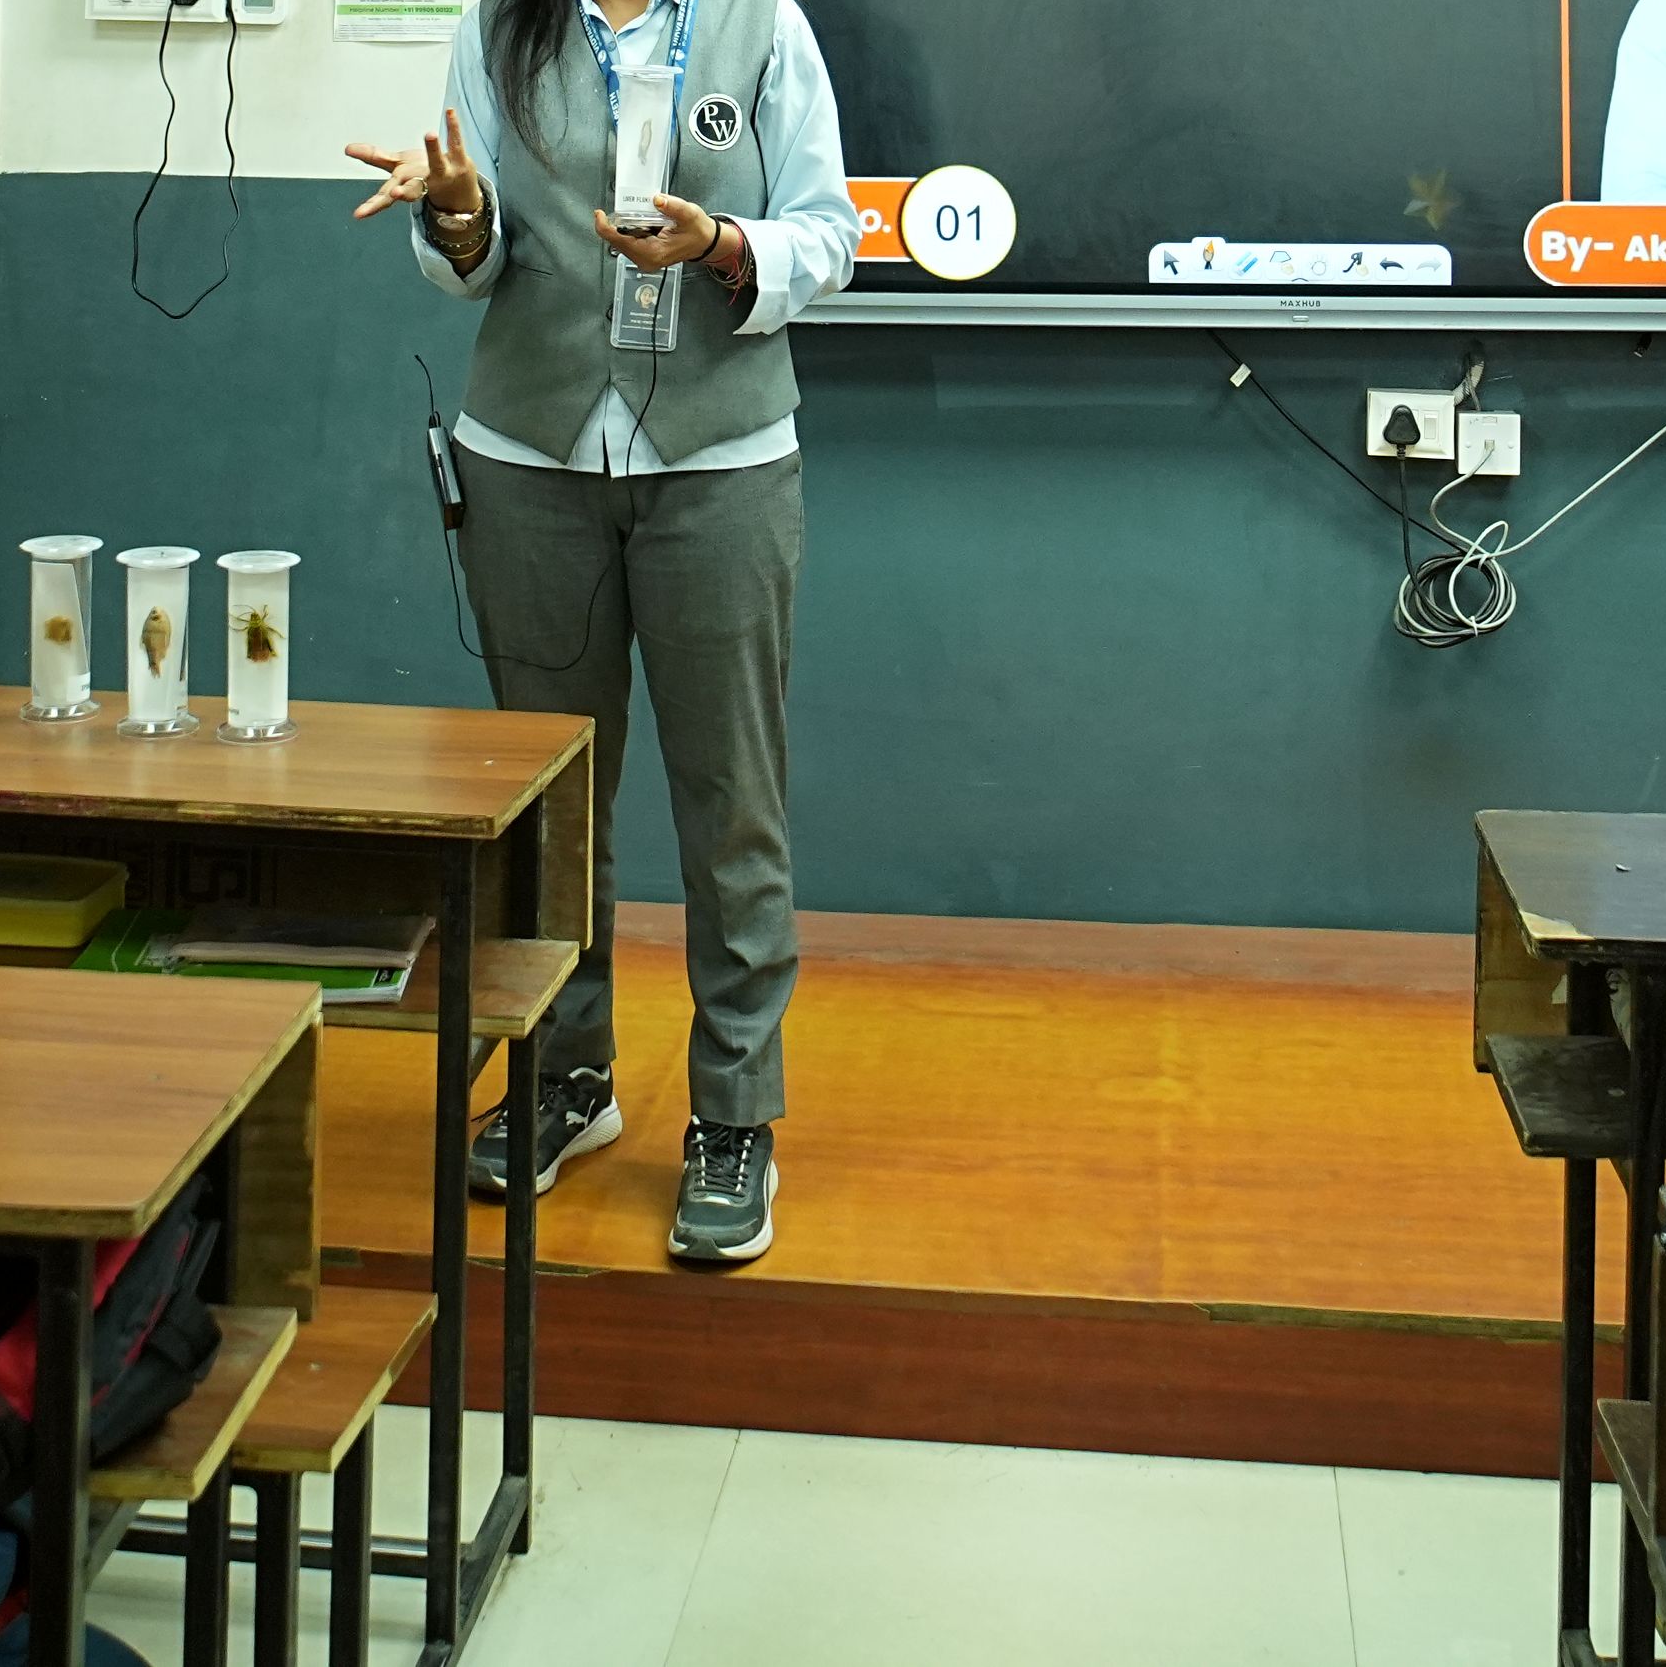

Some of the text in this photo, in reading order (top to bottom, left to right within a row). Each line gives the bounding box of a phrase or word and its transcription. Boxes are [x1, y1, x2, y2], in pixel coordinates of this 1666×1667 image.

[857, 209, 891, 233] o.
[936, 205, 980, 241] 01
[1541, 230, 1613, 271] By-
[1280, 299, 1321, 308] MAXHUB
